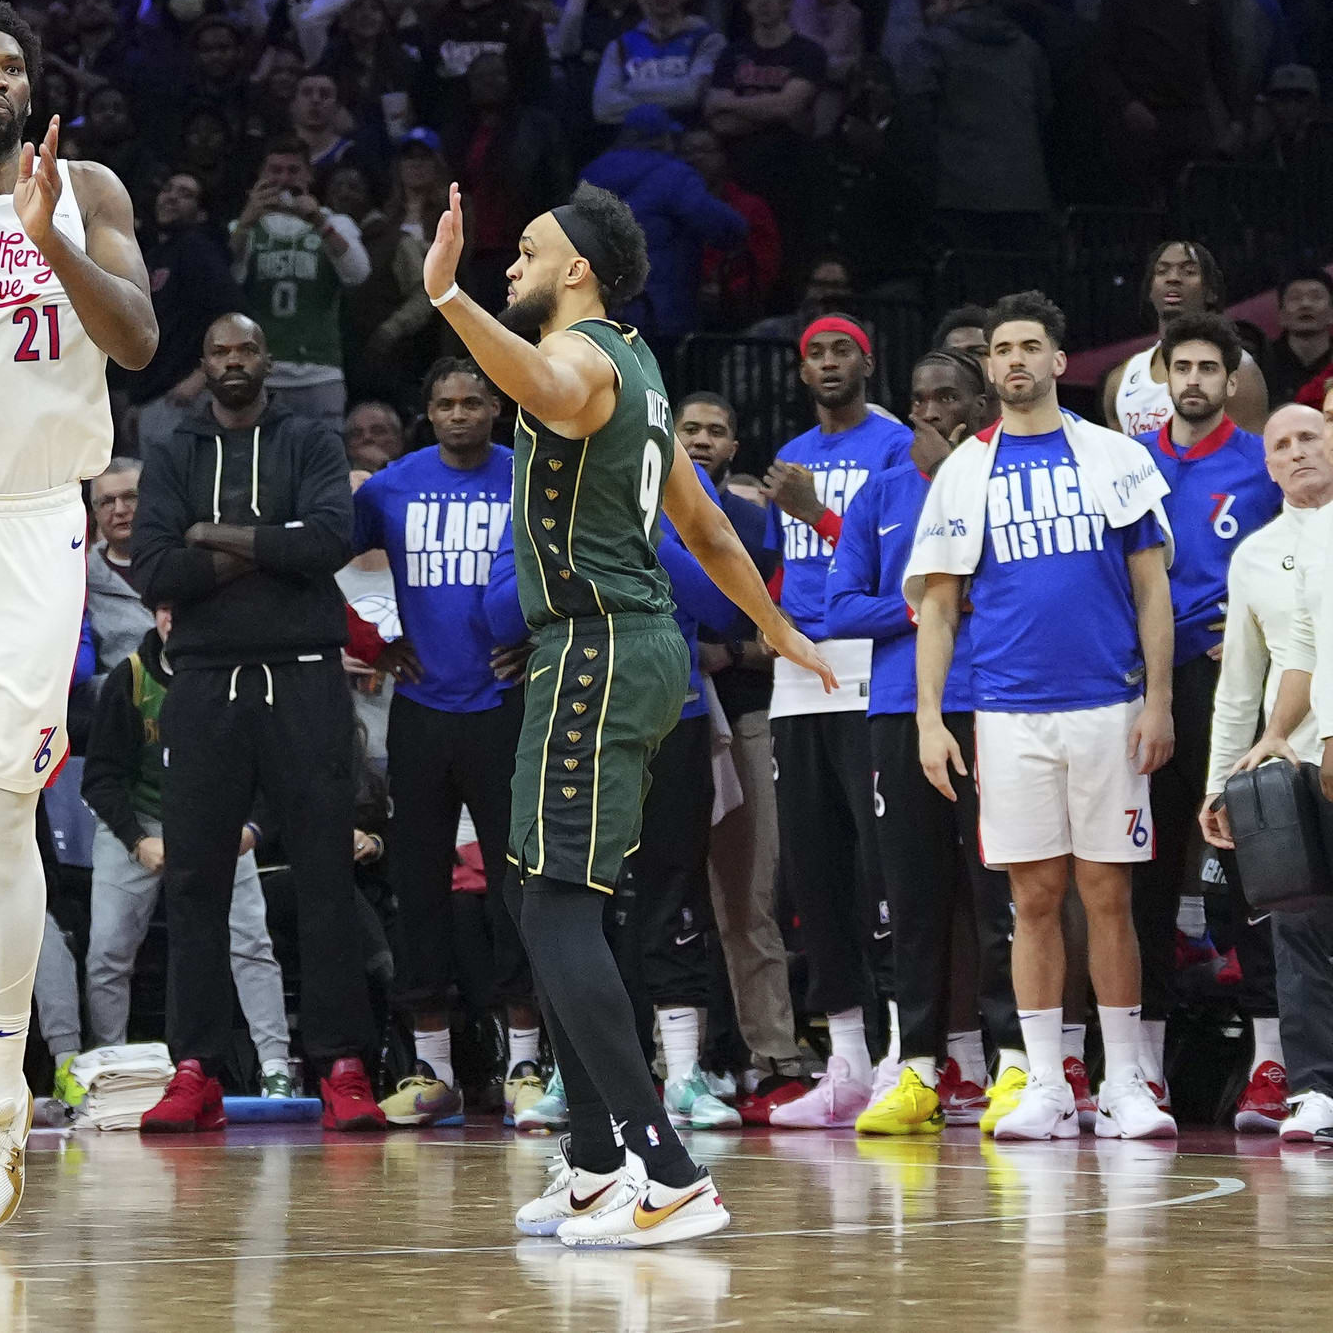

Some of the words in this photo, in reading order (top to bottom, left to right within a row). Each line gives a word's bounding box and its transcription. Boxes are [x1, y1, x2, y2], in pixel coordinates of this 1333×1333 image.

[12, 304, 60, 362] 21
[639, 438, 663, 543] 9
[987, 465, 1105, 528] BLACK
[405, 500, 511, 552] BLACK
[991, 514, 1106, 564] HISTORY
[1209, 493, 1239, 540] 76
[405, 550, 497, 587] HISTOR
[33, 725, 58, 774] 76
[1124, 807, 1149, 848] 76
